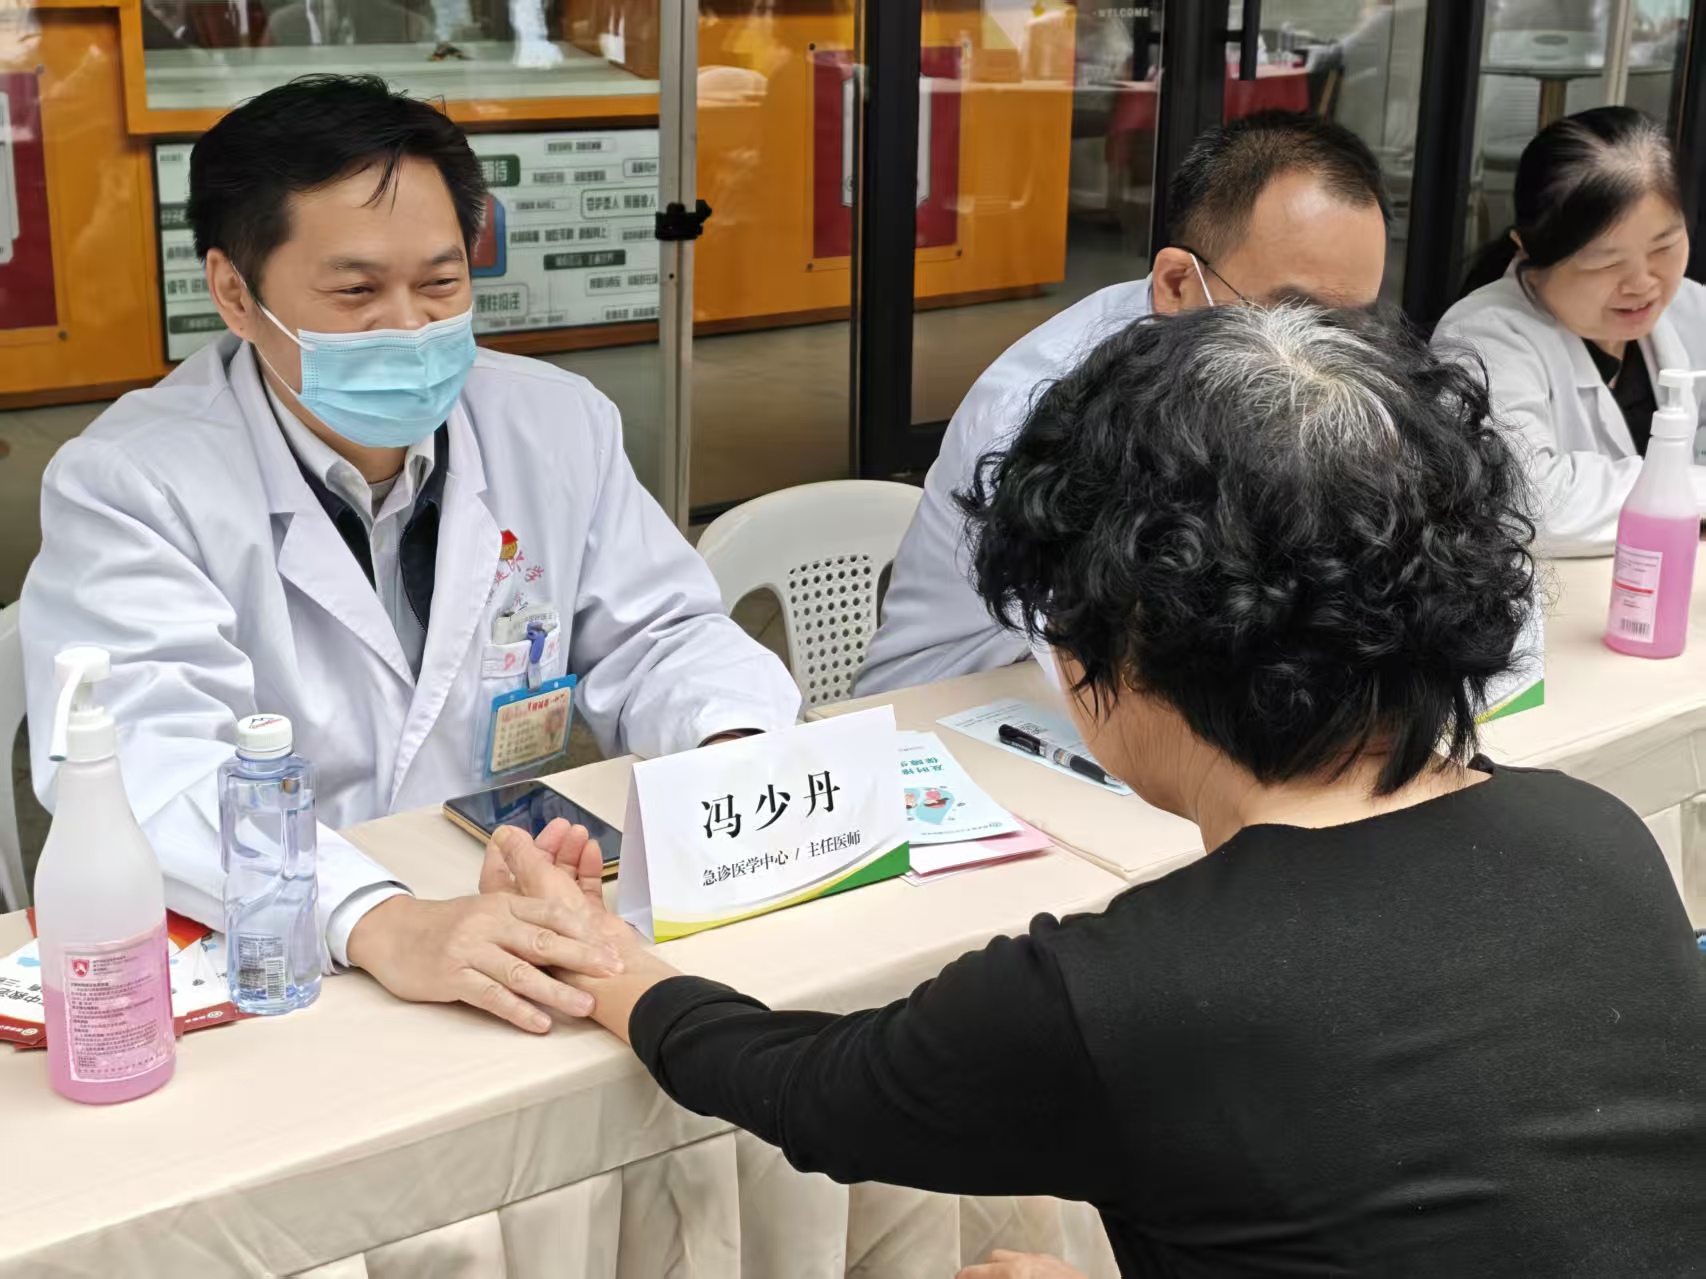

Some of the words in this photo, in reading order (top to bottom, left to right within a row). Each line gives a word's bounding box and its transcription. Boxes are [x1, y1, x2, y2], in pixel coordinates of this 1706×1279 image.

[1098, 8, 1149, 17] WELCOME
[701, 770, 841, 839] 冯少丹
[702, 850, 789, 887] 急诊医学中心
[807, 829, 861, 858] 主任医师
